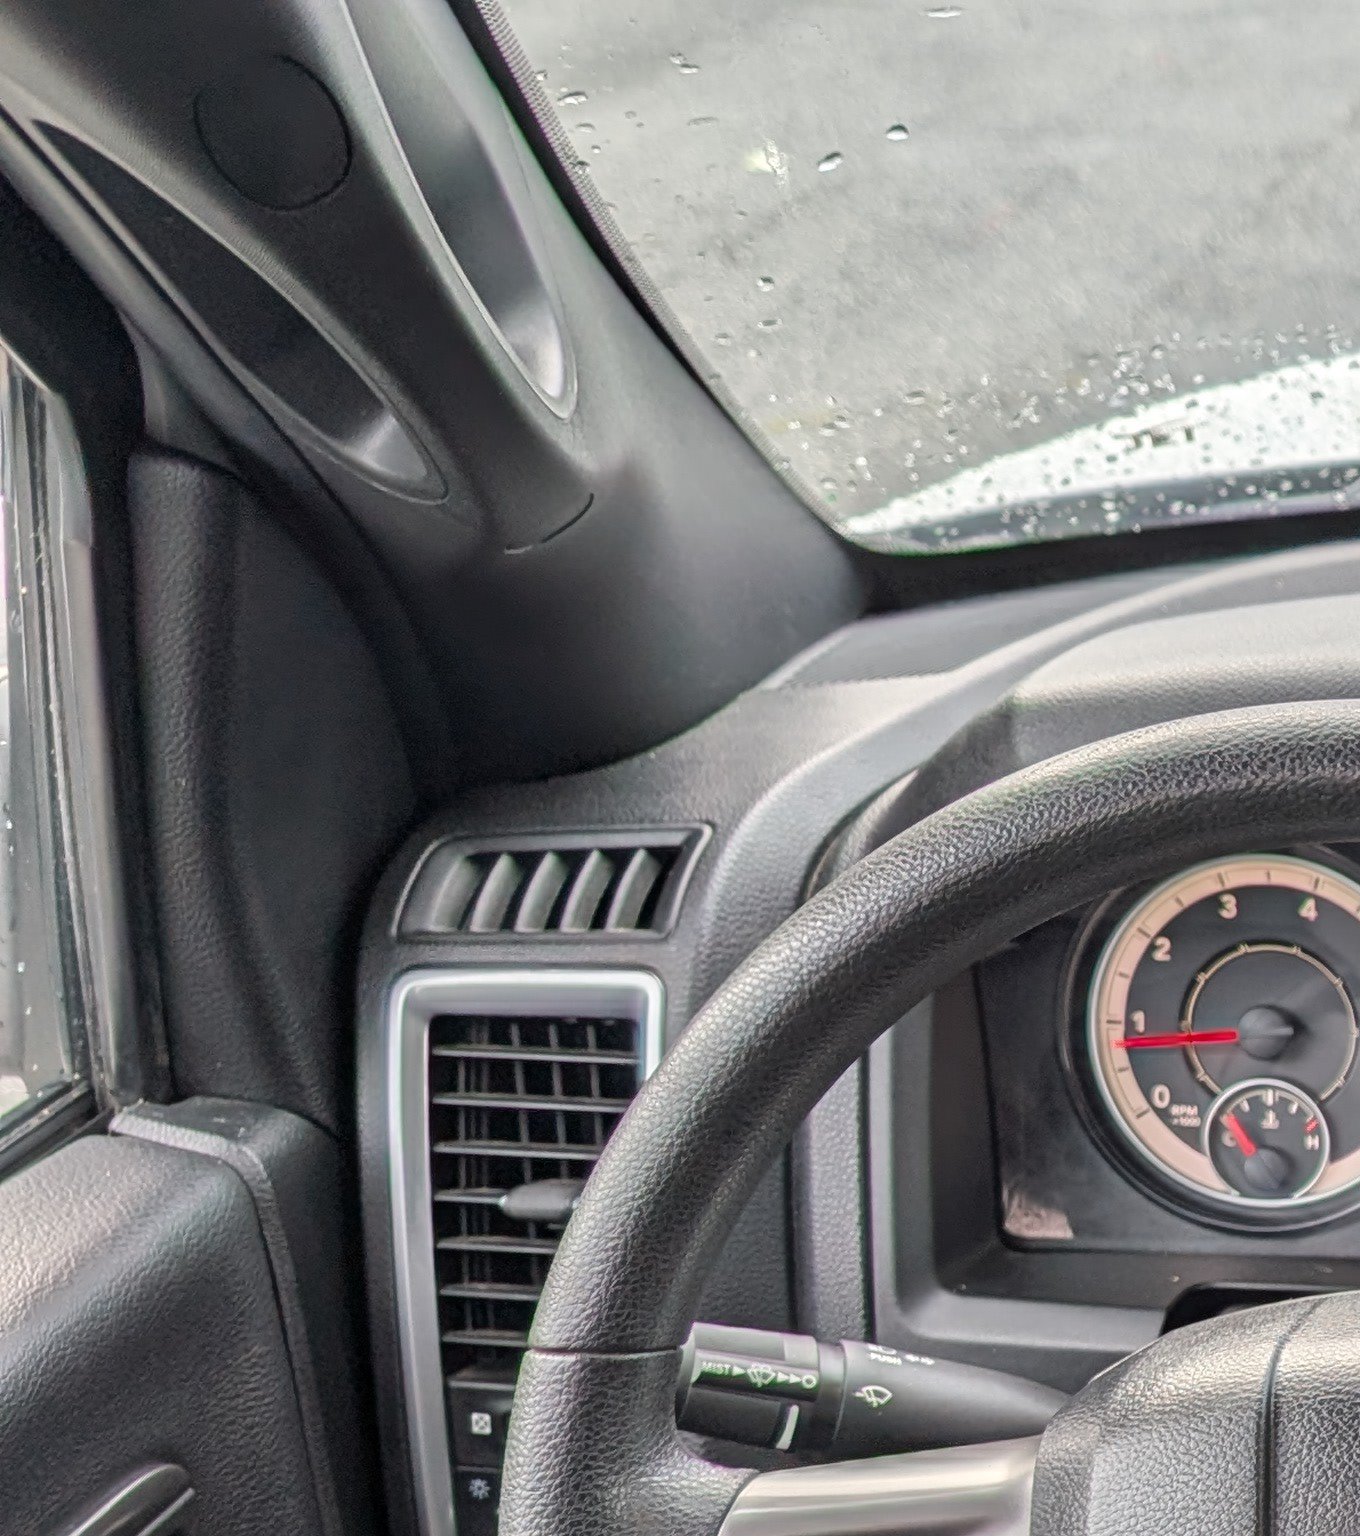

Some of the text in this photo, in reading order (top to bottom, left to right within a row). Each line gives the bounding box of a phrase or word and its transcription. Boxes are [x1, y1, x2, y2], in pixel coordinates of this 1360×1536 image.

[1219, 894, 1237, 919] 3
[1299, 898, 1318, 922] 4
[1152, 936, 1171, 962] 2
[1131, 1010, 1145, 1034] 1
[1151, 1084, 1171, 1109] 0
